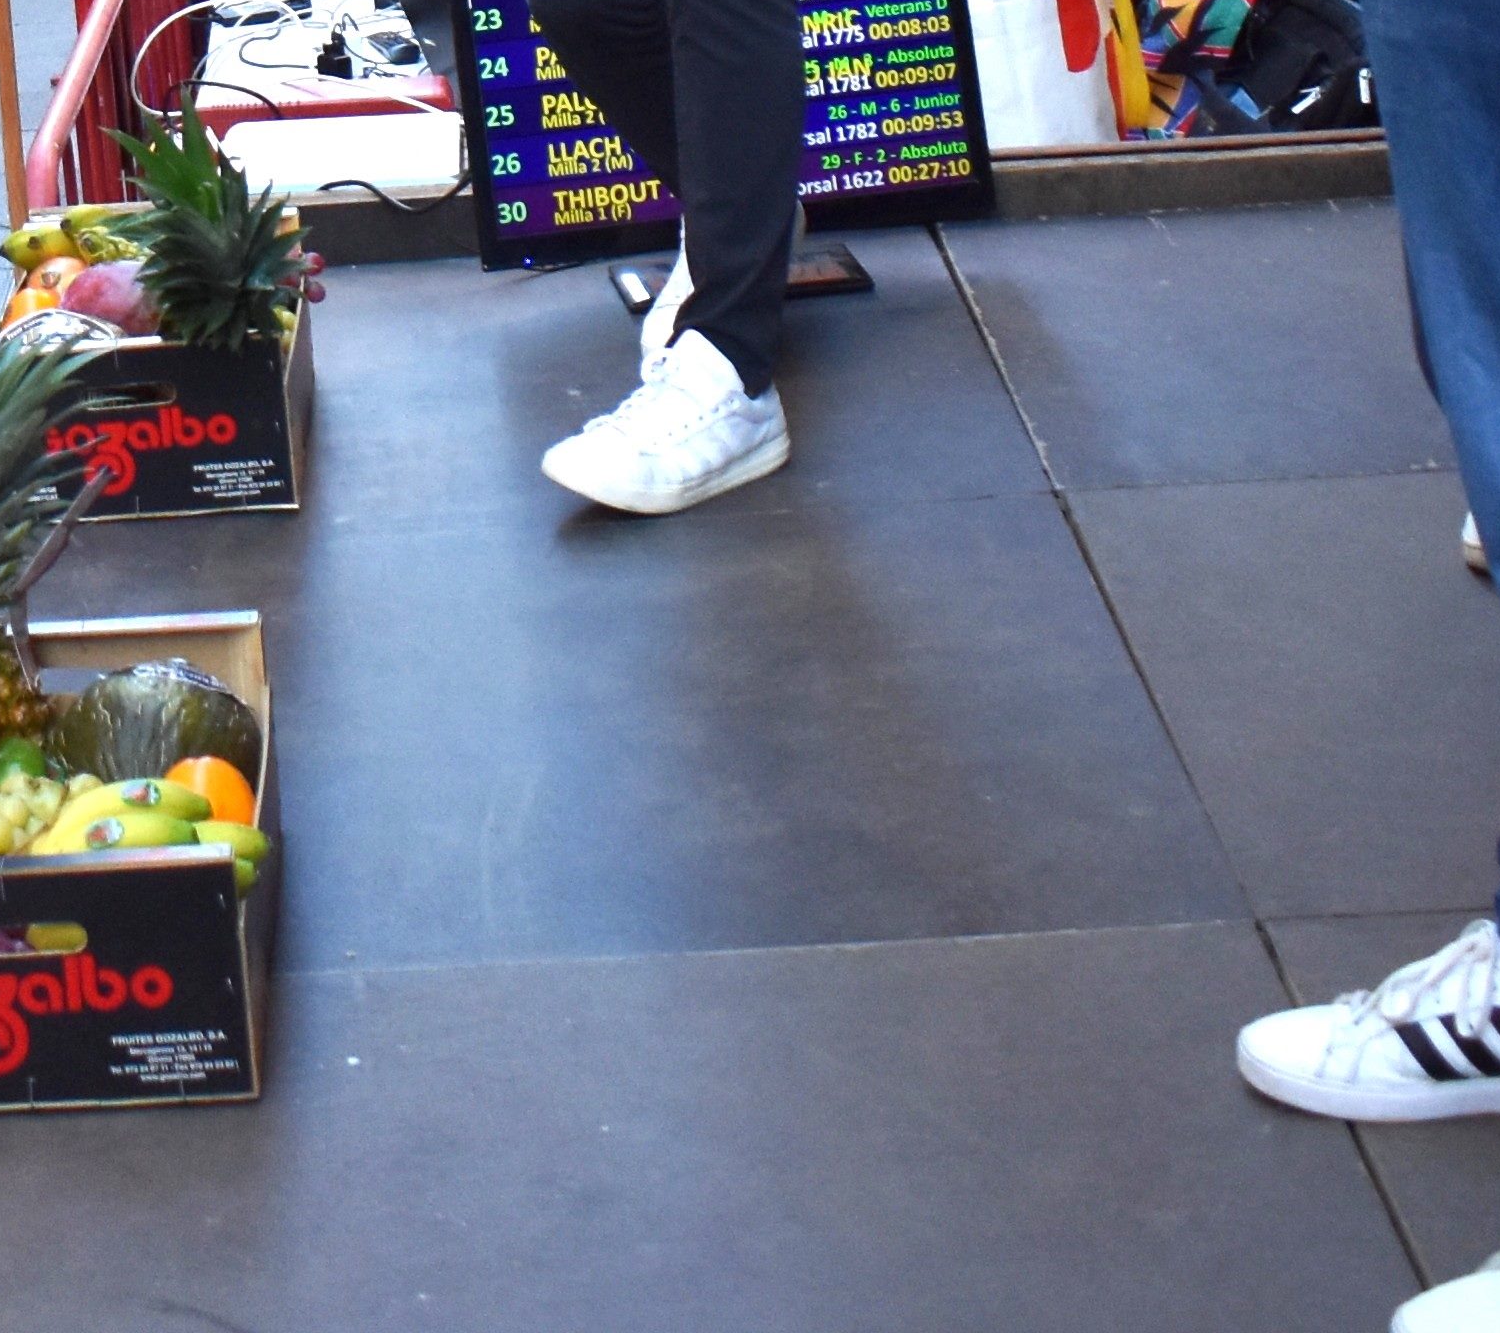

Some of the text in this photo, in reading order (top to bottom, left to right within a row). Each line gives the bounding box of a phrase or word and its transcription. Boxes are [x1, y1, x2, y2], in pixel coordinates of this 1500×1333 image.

[472, 8, 503, 31] 23
[864, 0, 932, 18] Veterans
[869, 14, 950, 41] 00:08:03
[479, 56, 509, 79] 24
[887, 45, 955, 65] Absoluta
[875, 62, 957, 88] 00:09:07
[485, 104, 515, 127] 25
[828, 105, 848, 120] 26
[860, 101, 877, 116] M
[890, 98, 901, 113] 6
[913, 92, 961, 110] Junior
[541, 111, 582, 130] Milla
[586, 110, 595, 125] 2
[836, 122, 879, 142] 1782
[881, 110, 964, 136] 00:09:53
[491, 135, 622, 176] 26 LLACH
[547, 153, 634, 178] Milla 2 (M)
[821, 154, 841, 170] 29
[854, 151, 863, 166] F
[876, 148, 886, 163] 2
[900, 140, 968, 161] Absoluta
[842, 169, 885, 190] 1622
[888, 157, 971, 184] 00:27:10
[497, 179, 662, 224] 30 THIBOUT
[554, 201, 632, 226] Milla 1 (F)
